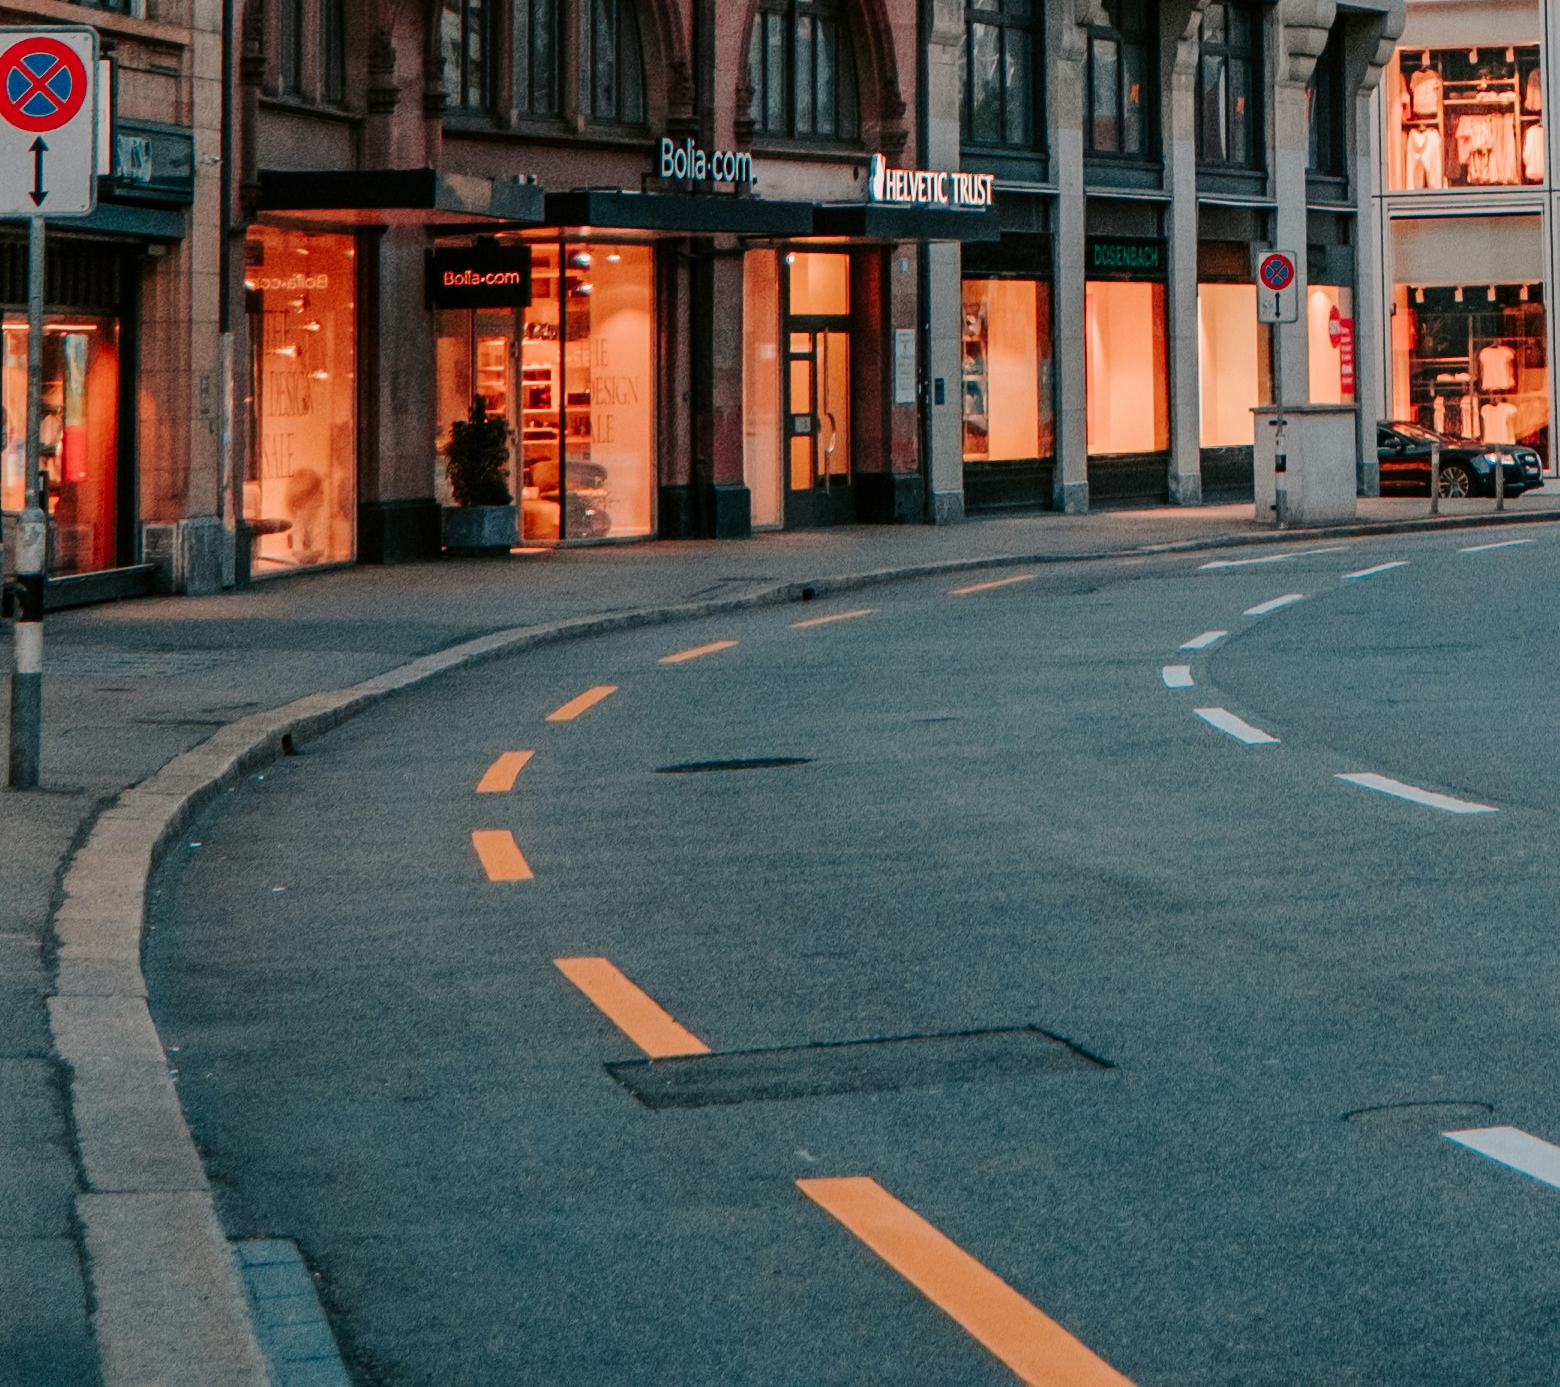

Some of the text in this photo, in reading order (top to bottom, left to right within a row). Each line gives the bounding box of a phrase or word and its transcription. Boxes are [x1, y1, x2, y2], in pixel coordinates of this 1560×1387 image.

[886, 169, 994, 205] HELVETIC TRUST
[1094, 244, 1159, 267] DOSENBACH
